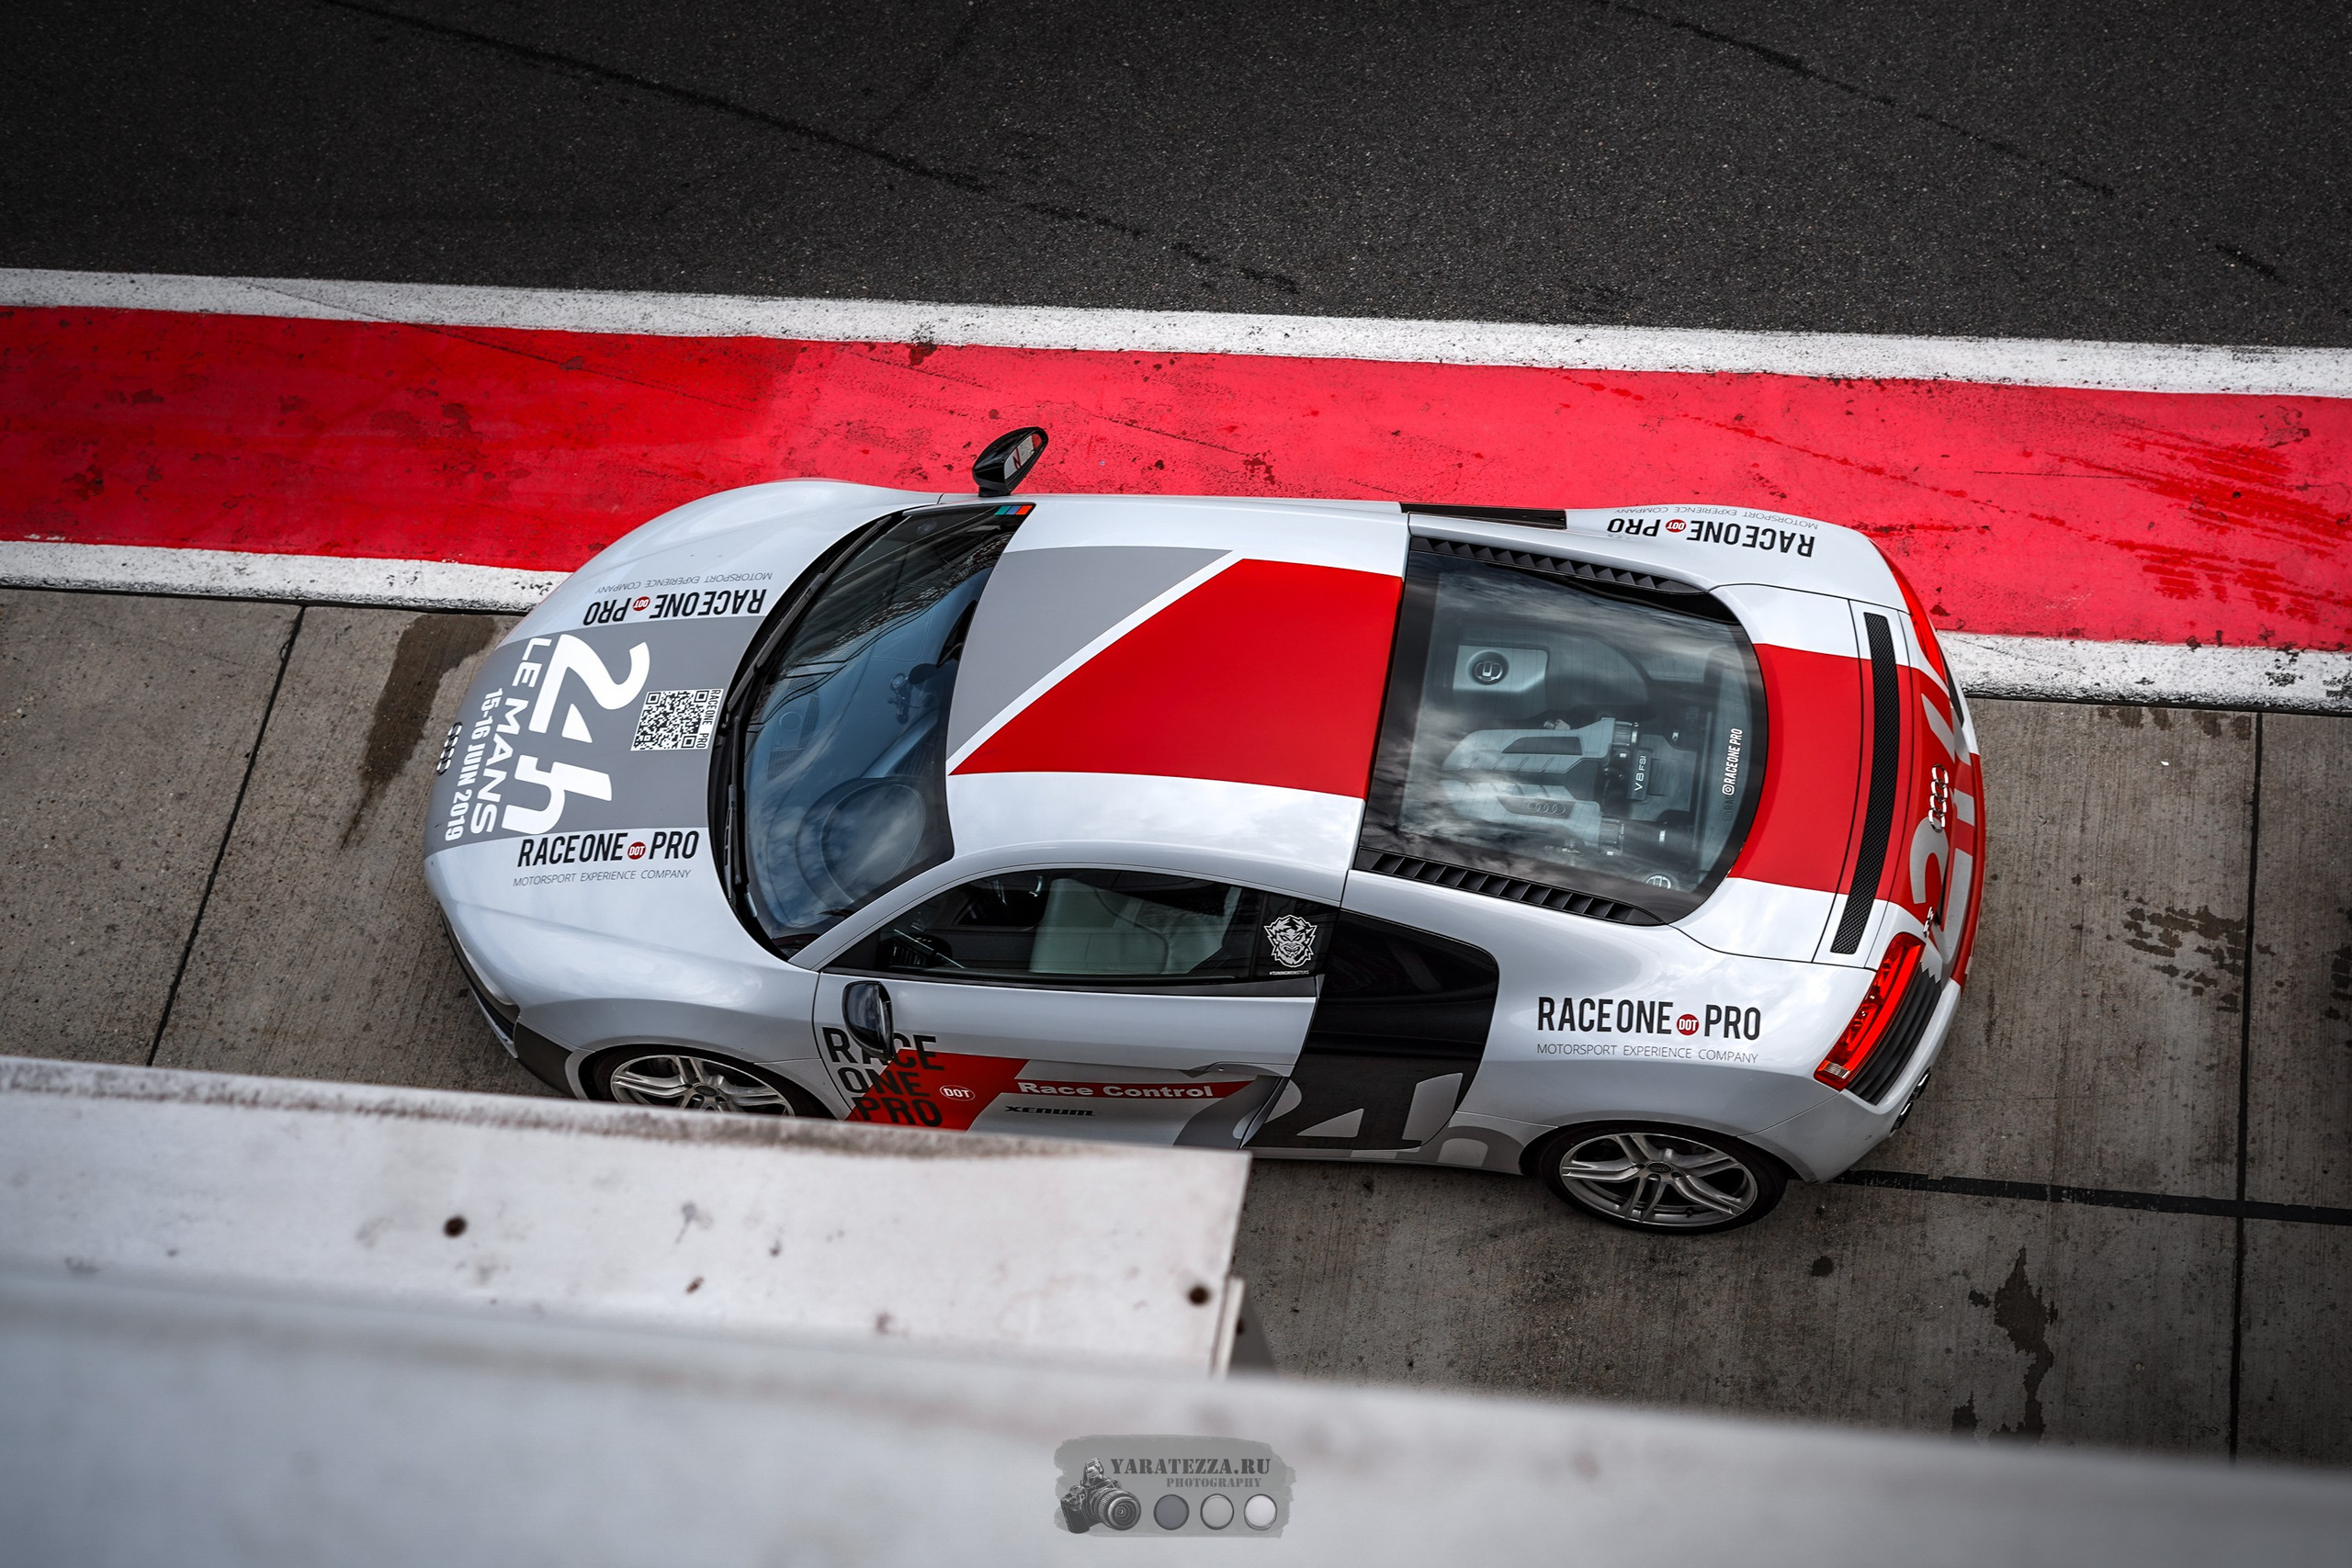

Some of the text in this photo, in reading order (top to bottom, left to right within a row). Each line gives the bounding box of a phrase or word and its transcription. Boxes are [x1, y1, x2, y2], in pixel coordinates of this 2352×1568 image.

[1674, 506, 1737, 516] EXPERIENCE
[1742, 511, 1819, 530] MOTORSPORT
[1607, 518, 1815, 558] RACEONE DOT PRO
[595, 572, 774, 594] MOTORSPORT EXPERIENCE COMPANY
[582, 589, 767, 626] RACEONE DOT PRO
[696, 689, 721, 749] RACEONE PRO
[470, 637, 552, 834] LE MANS
[1730, 728, 1743, 746] PRO
[445, 687, 503, 841] 15-16 JUIN 2019
[517, 830, 699, 867] RACEONE DOT PRO
[513, 869, 692, 887] MOTORSPORT EXPERIENCE COMPANY
[1537, 997, 1761, 1041] RACEONE DOT PRO
[1537, 1043, 1758, 1064] MOTORSPORT EXPERIENCE COMPANY
[837, 1066, 931, 1097] ONE
[943, 1088, 970, 1099] DOT
[1018, 1082, 1214, 1098] Race Control
[851, 1096, 943, 1127] PRO
